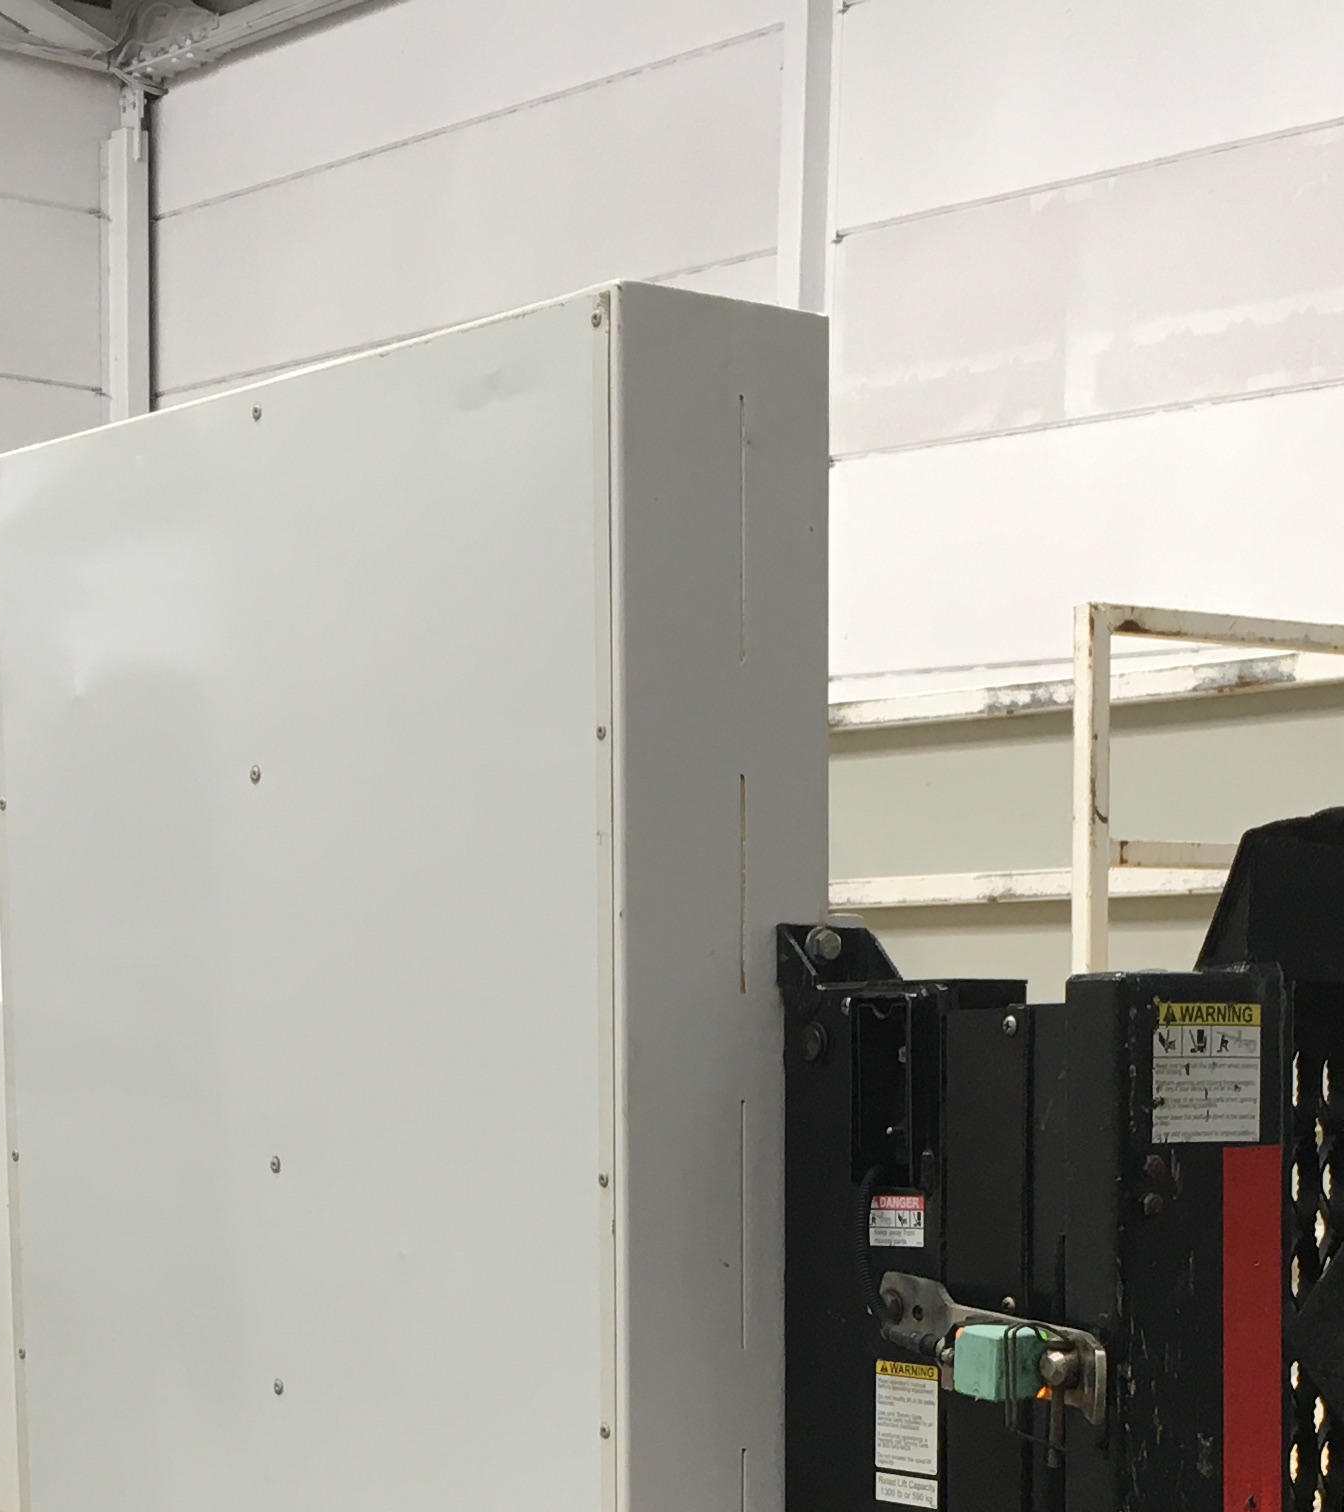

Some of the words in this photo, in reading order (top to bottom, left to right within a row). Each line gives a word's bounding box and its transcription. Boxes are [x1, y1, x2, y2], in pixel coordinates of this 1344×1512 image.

[1180, 1005, 1253, 1023] WARNING
[879, 1196, 920, 1209] DANGER
[889, 1363, 934, 1378] WARNING
